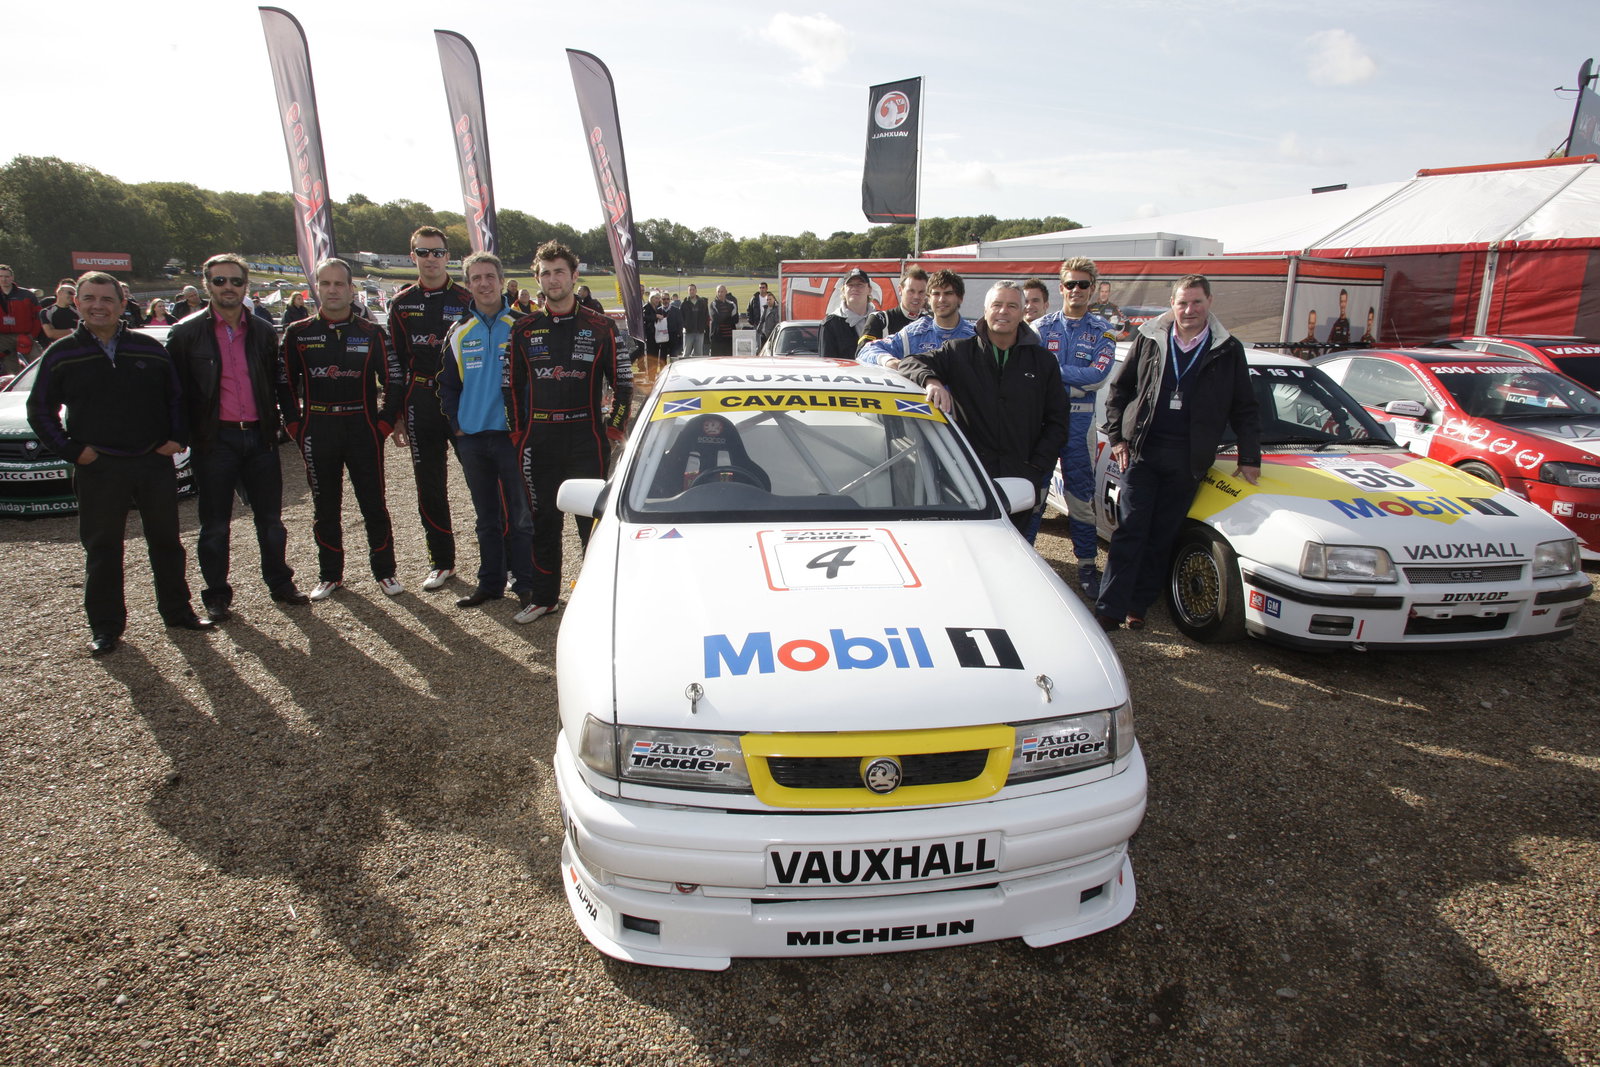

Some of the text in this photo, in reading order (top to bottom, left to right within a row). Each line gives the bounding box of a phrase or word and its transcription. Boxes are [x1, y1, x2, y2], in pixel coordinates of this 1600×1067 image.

[1267, 369, 1288, 377] 16
[1291, 370, 1304, 378] V
[1430, 366, 1475, 374] 2004
[688, 374, 907, 389] VAUXHALL
[719, 394, 883, 410] CAVALIER
[408, 406, 421, 465] VAUXHALL
[303, 436, 320, 499] VAUXHALL
[523, 447, 538, 512] VAUXHALL
[1334, 468, 1416, 488] 56
[1215, 479, 1242, 497] Cleland
[1328, 496, 1472, 520] Mobil
[1553, 502, 1573, 515] RS
[1403, 543, 1525, 560] VAUXHALL
[806, 545, 857, 579] 4
[1267, 599, 1279, 611] GM
[1440, 592, 1509, 602] DUNLOP
[703, 627, 1001, 679] Mobil 1
[1038, 732, 1090, 747] Auto
[649, 743, 715, 757] Auto
[1022, 741, 1105, 763] Trader
[631, 754, 731, 772] Trader
[770, 838, 996, 884] VAUXHALL
[575, 883, 599, 921] ALPHA
[787, 919, 975, 946] MICHELIN
